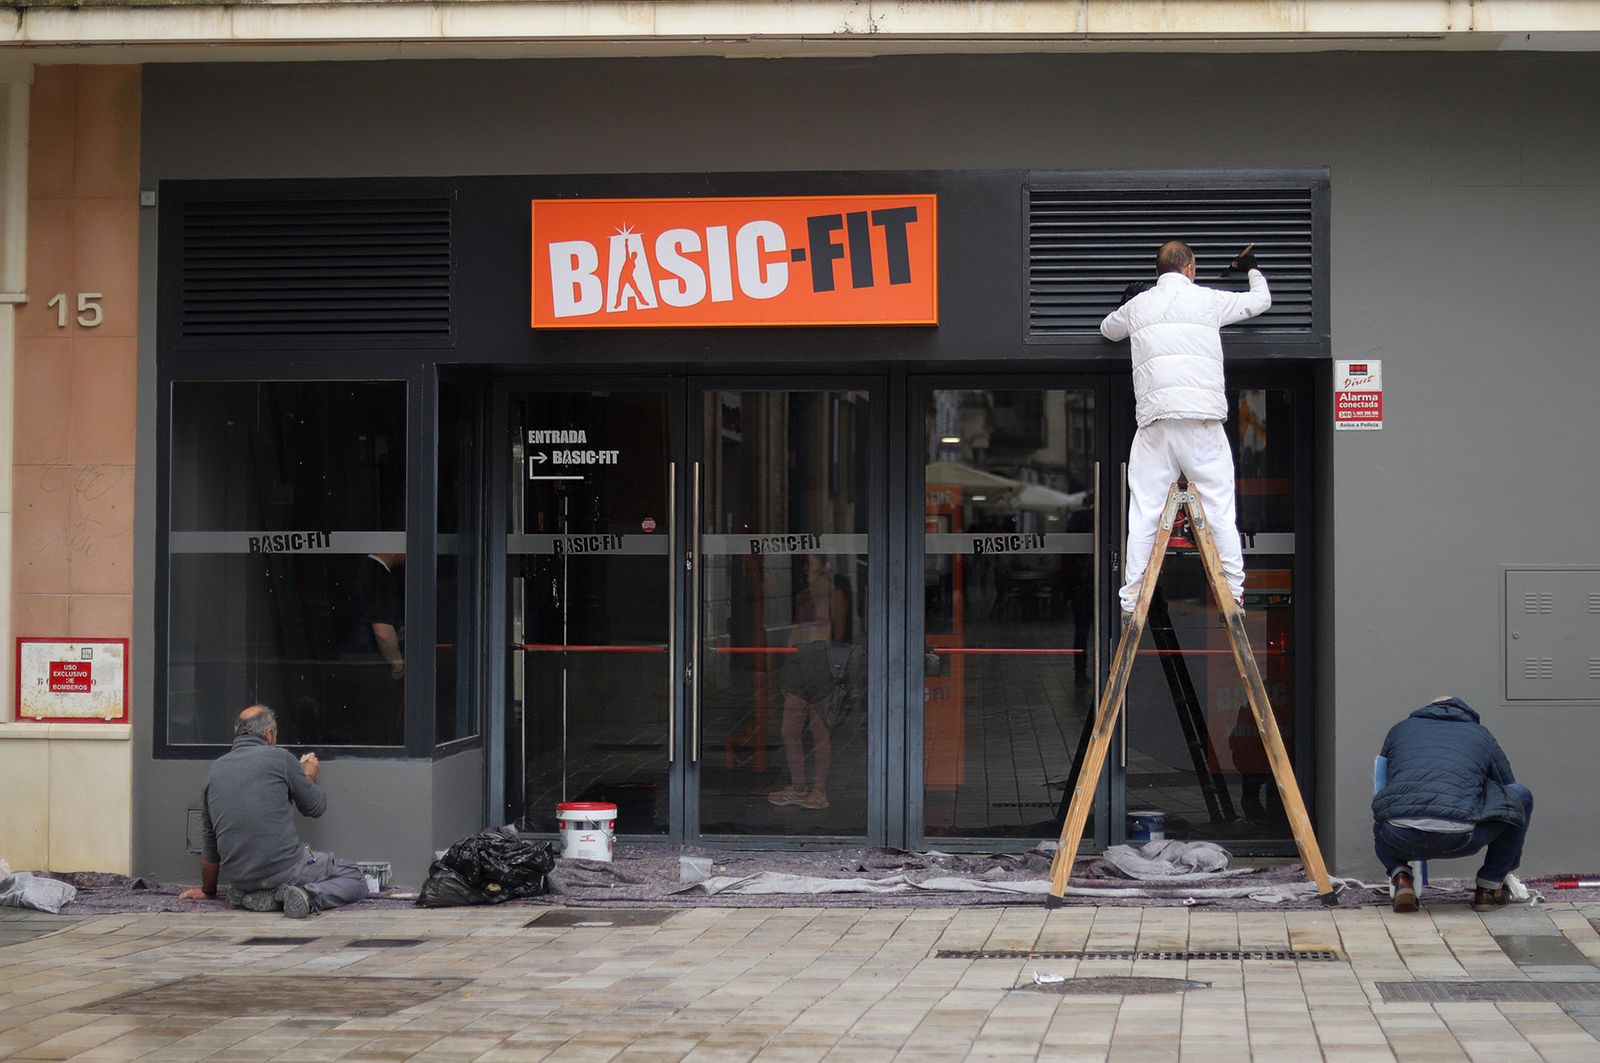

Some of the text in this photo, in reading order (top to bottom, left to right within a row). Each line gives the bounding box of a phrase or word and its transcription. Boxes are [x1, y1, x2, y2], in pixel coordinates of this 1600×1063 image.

[548, 206, 919, 319] BASIC-FIT
[47, 292, 104, 327] 15
[1339, 392, 1379, 401] Alarma
[528, 430, 587, 444] ENTRADA
